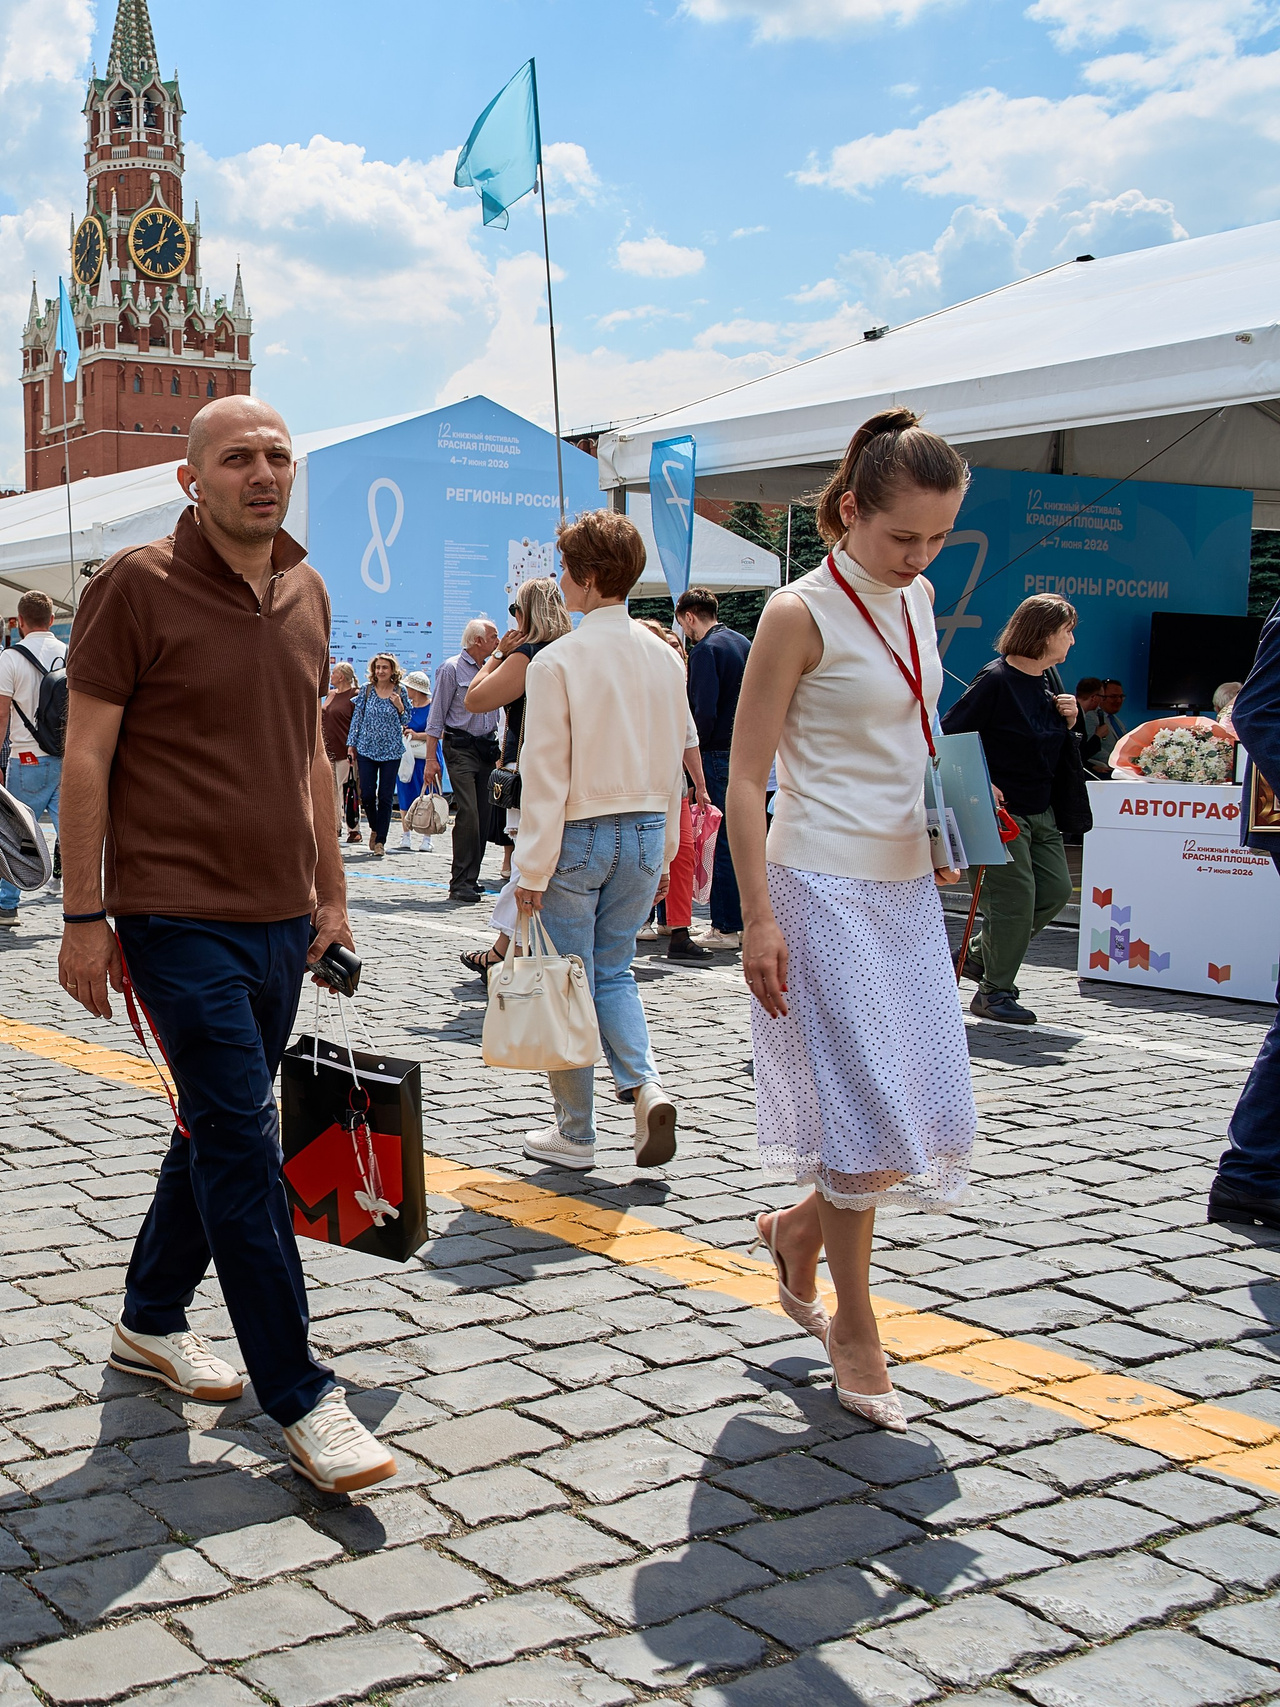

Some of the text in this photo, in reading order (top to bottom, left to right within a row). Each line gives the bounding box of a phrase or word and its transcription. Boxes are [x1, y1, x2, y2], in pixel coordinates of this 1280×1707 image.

[438, 422, 519, 443] 12 КНИЖНЫЙ ФЕСТИВАЛЬ
[437, 440, 521, 455] КРАСНАЯ ПЛОЩАДЬ
[488, 459, 509, 469] 2026
[446, 488, 569, 509] РЕГИОНЫ РОССИИ
[1027, 488, 1122, 515] 12 КНИЖНЫЙ ФЕСТИВАЛЬ
[1026, 513, 1123, 531] КРАСНАЯ ПЛОЩАДЬ
[1084, 539, 1109, 551] 2026
[1024, 574, 1168, 598] РЕГИОНЫ РОССИИ
[1183, 839, 1196, 852] 12
[1182, 852, 1270, 866] КРАСНАЯ ПЛОЩАДЬ
